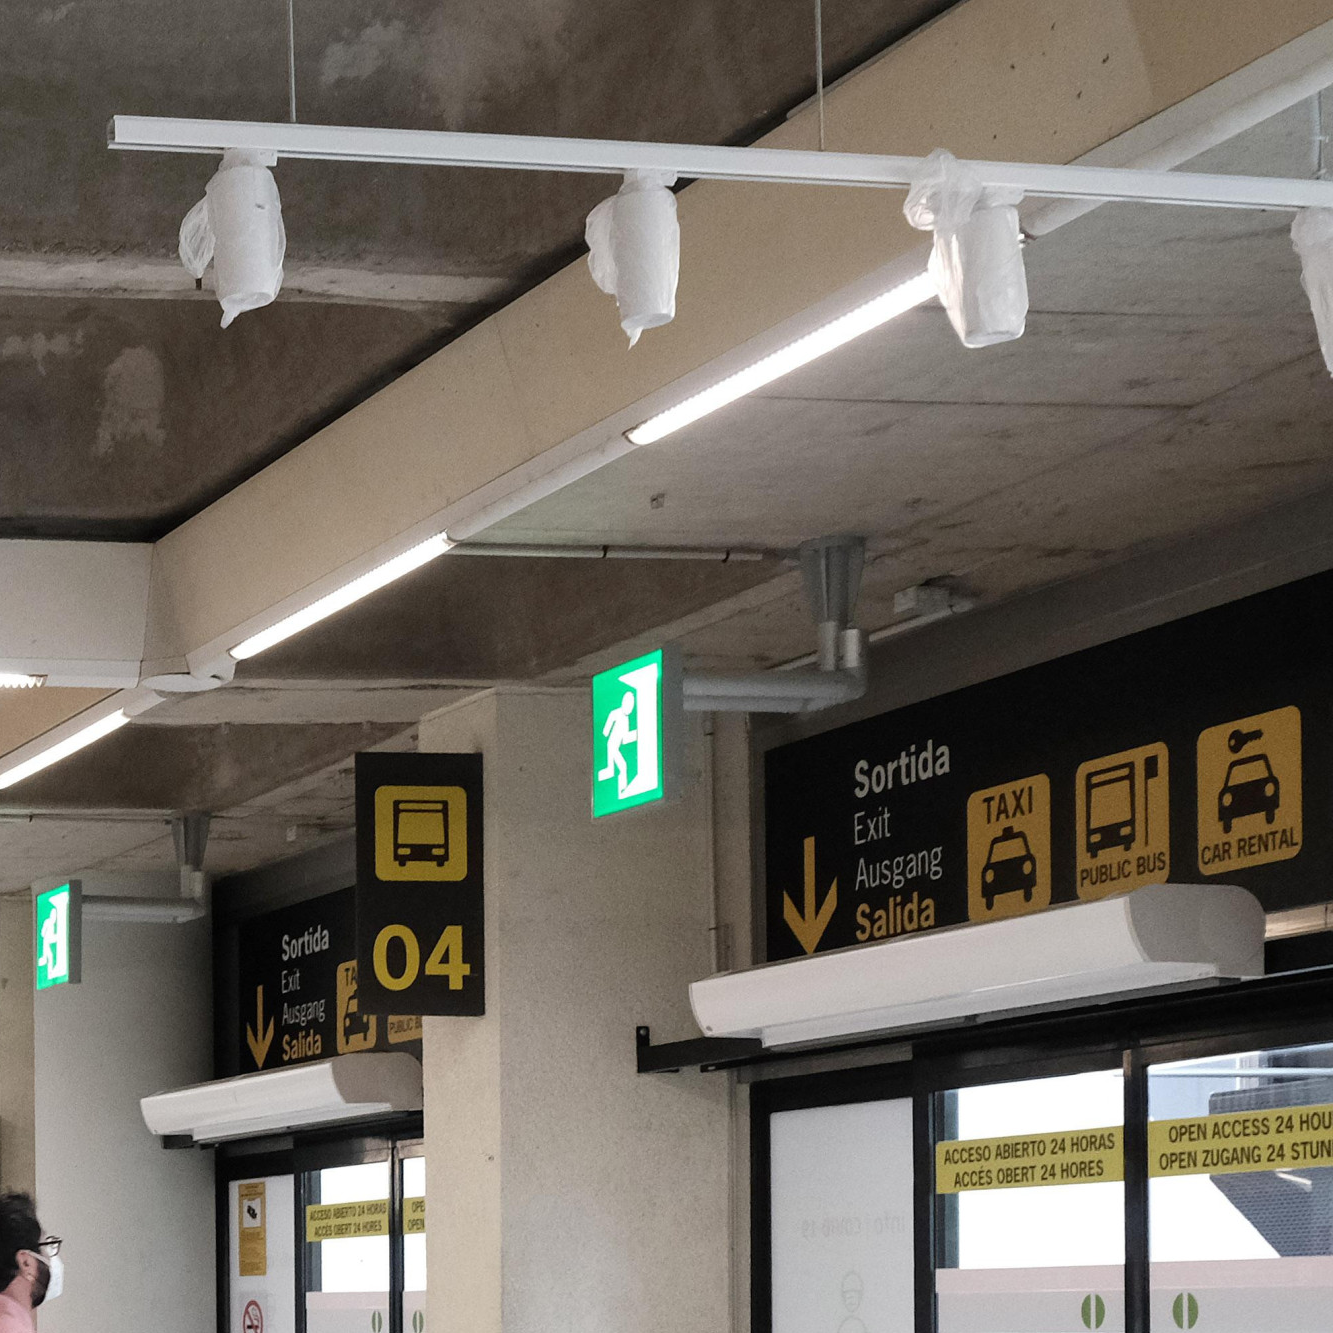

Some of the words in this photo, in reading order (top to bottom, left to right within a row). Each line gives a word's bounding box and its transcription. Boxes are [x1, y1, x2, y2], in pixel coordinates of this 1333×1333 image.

[854, 739, 950, 798] Sortida
[983, 786, 1033, 824] TAXI
[854, 806, 891, 845] Exit
[1201, 843, 1231, 866] CAR
[1238, 826, 1299, 859] RENTAL
[855, 846, 943, 891] Ausgang
[1080, 860, 1131, 887] PUBLIC
[1136, 852, 1166, 876] BUS
[855, 891, 935, 941] Salida
[282, 924, 330, 962] Sortida
[372, 924, 471, 991] 04
[282, 970, 301, 994] Exit
[282, 999, 326, 1027] Ausgang
[282, 1029, 322, 1061] Salida
[1168, 1123, 1207, 1143] OPEN
[1212, 1117, 1270, 1139] ACCESS
[1275, 1115, 1294, 1134] 24
[1299, 1111, 1333, 1131] HOU
[944, 1146, 991, 1165] ACCESO
[995, 1140, 1046, 1160] ABIERTO
[1050, 1138, 1066, 1155] 24
[1071, 1133, 1115, 1153] HORAS
[1159, 1151, 1197, 1170] OPEN
[1202, 1146, 1261, 1167] ZUGANG
[1267, 1143, 1285, 1162] 24
[1291, 1140, 1333, 1160] STUN
[997, 1165, 1036, 1184] OBERT
[1041, 1164, 1056, 1181] 24
[1061, 1160, 1104, 1178] HORES
[310, 1209, 332, 1221] ACCESO
[333, 1206, 357, 1219] ABIERTO
[358, 1205, 365, 1217] 24
[366, 1202, 386, 1215] HORAS
[334, 1222, 352, 1236] OBERT
[354, 1222, 361, 1234] 24
[362, 1219, 382, 1233] HORES
